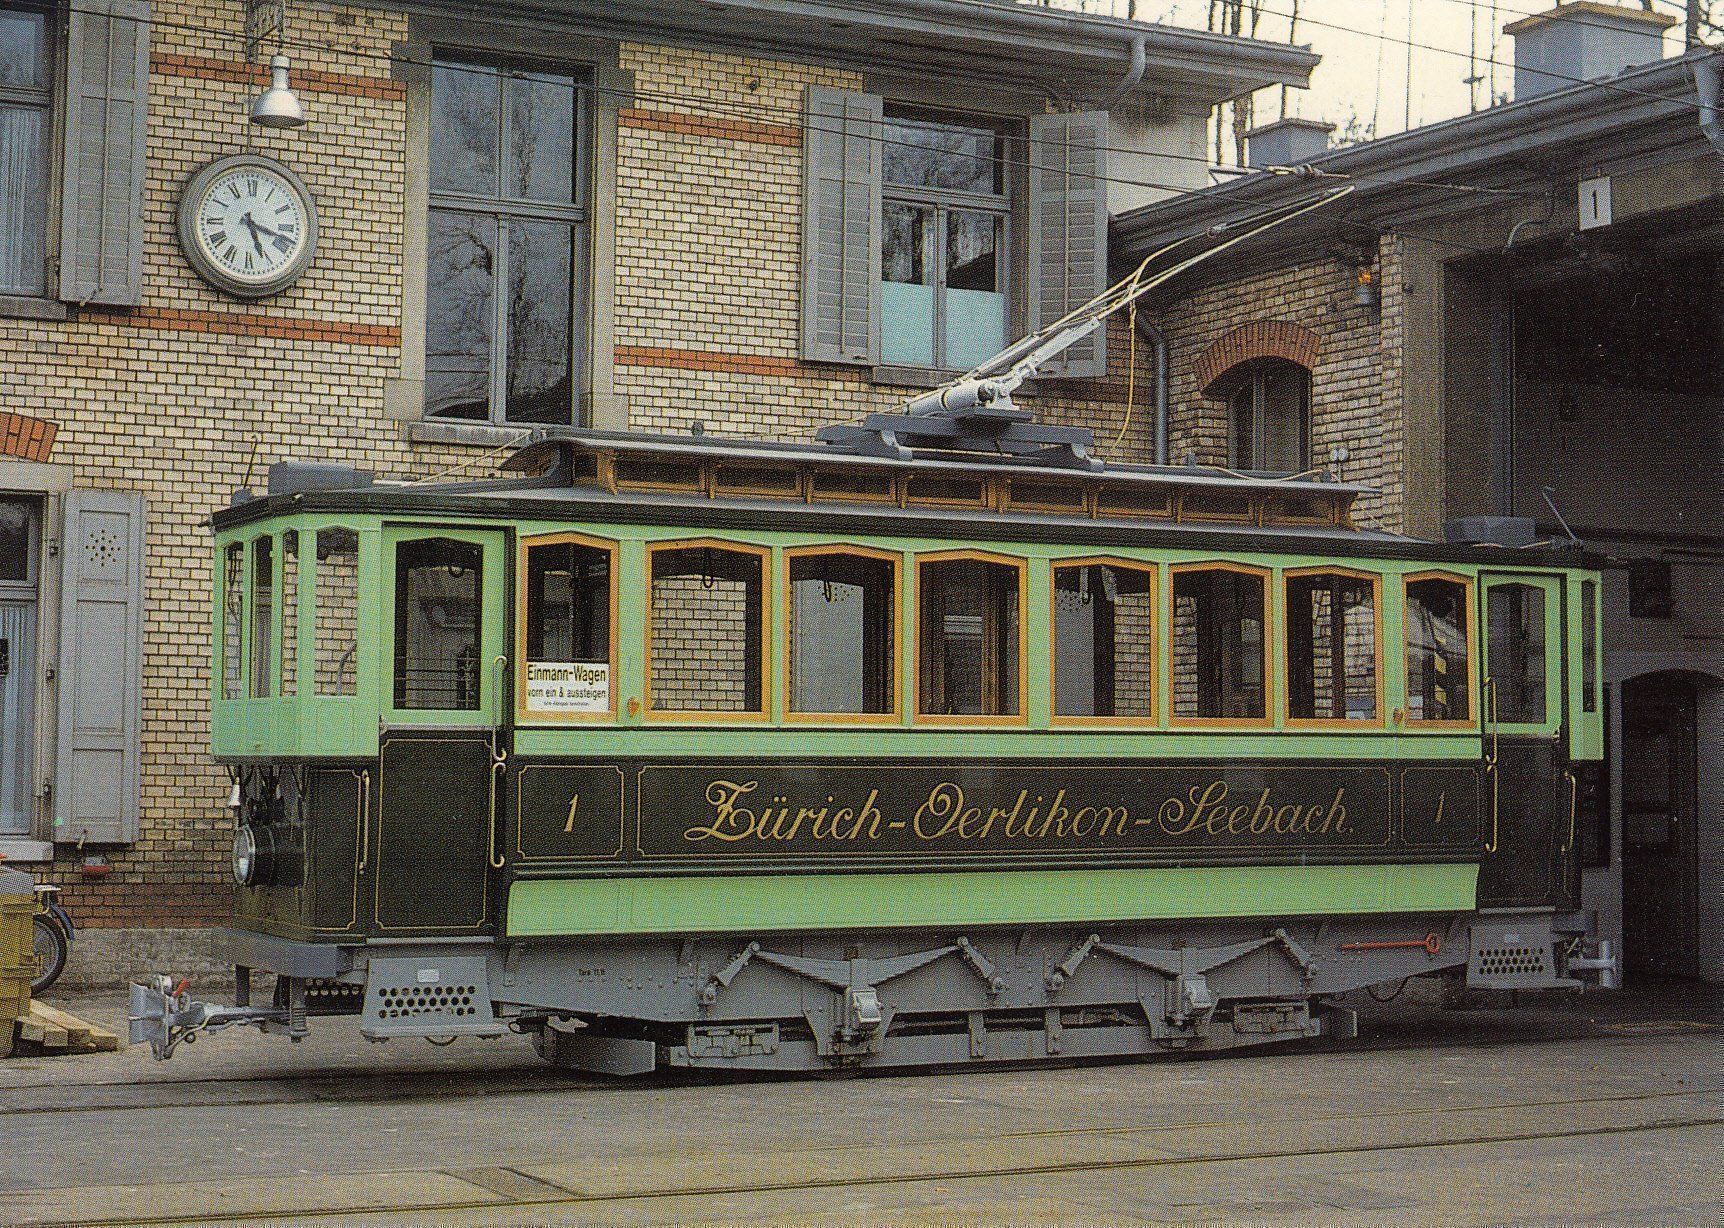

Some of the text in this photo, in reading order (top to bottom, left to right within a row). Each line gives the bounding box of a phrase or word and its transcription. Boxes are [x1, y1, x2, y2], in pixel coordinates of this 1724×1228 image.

[1592, 190, 1598, 219] 1
[527, 664, 606, 685] Einmann-Wagen
[545, 686, 557, 698] ein
[567, 687, 606, 700] aussteigen
[563, 793, 579, 832] 1
[1434, 792, 1445, 823] 1
